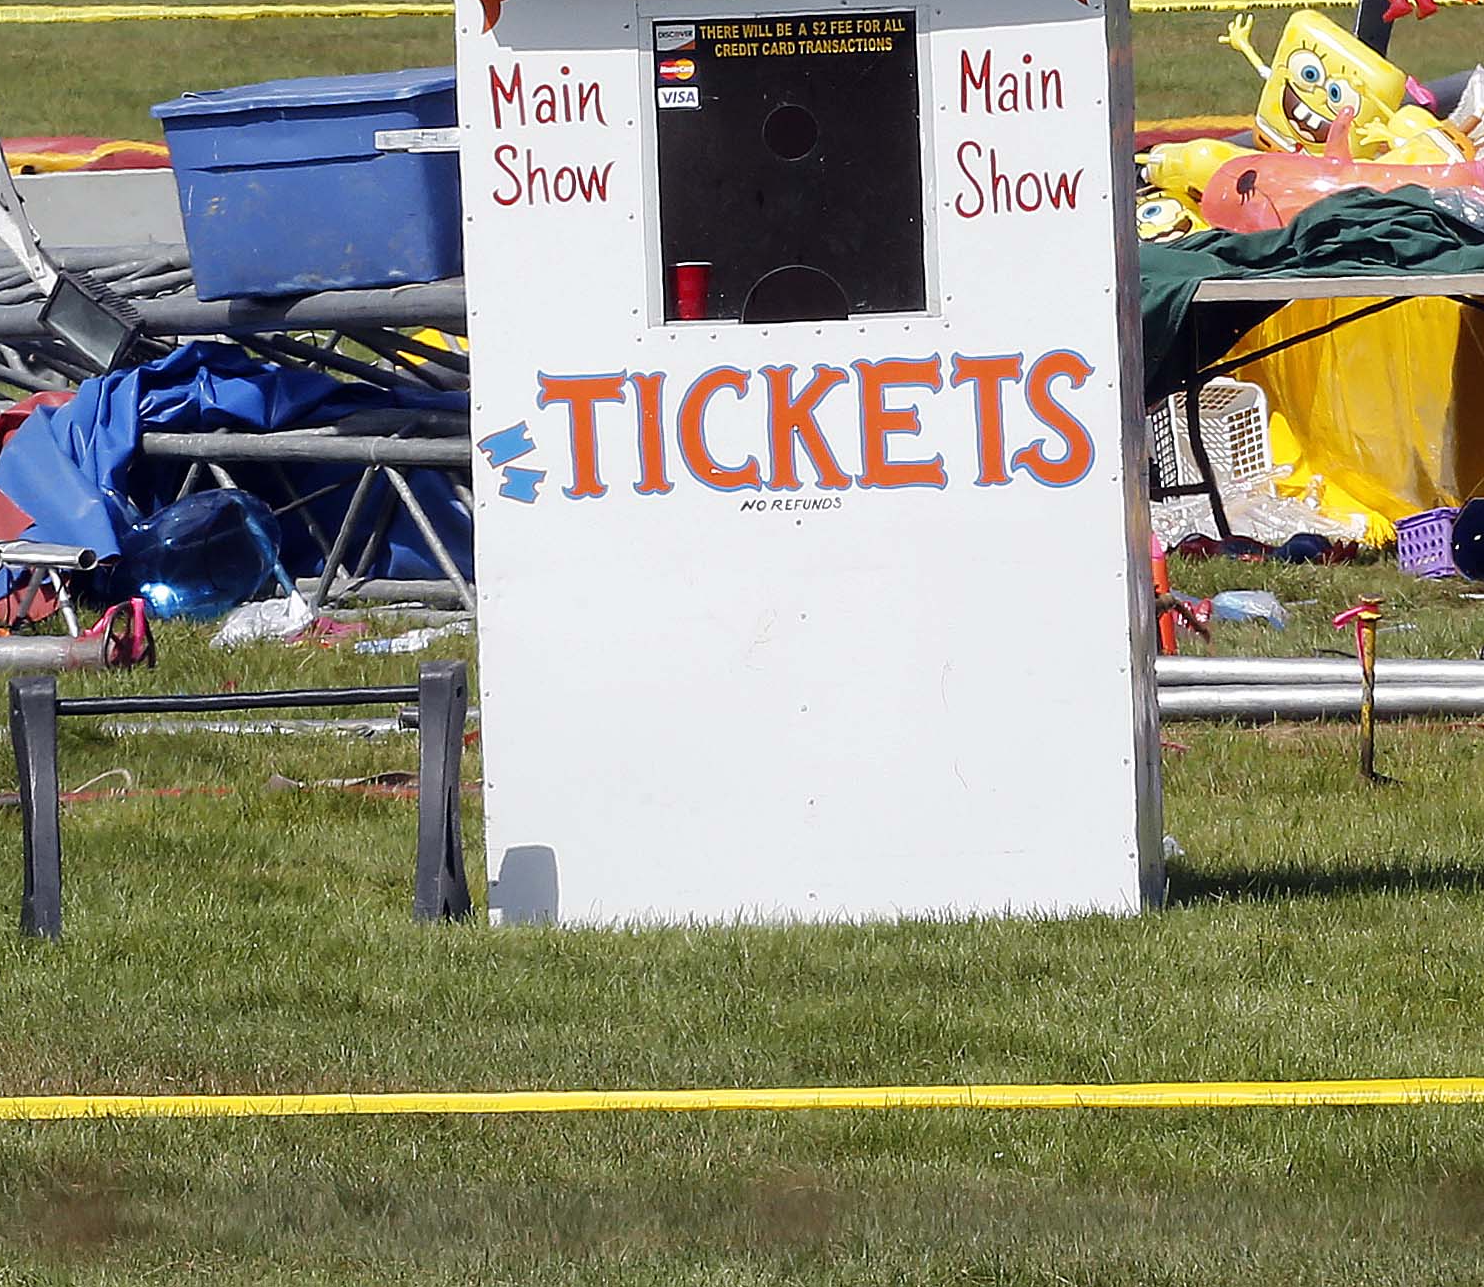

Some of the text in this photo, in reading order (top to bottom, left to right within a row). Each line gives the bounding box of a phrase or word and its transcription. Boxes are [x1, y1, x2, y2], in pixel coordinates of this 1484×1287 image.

[699, 18, 906, 40] THERE WILL BE A $2 FEE FOR ALL
[714, 37, 893, 57] CREDIT CARD TRANSACTIONS
[488, 63, 608, 129] Main
[661, 90, 696, 104] VISA
[959, 48, 1064, 114] Main
[491, 144, 616, 206] Show
[953, 140, 1085, 218] Show
[537, 349, 1096, 500] TICKETS
[740, 497, 842, 512] NO REFUNDS
